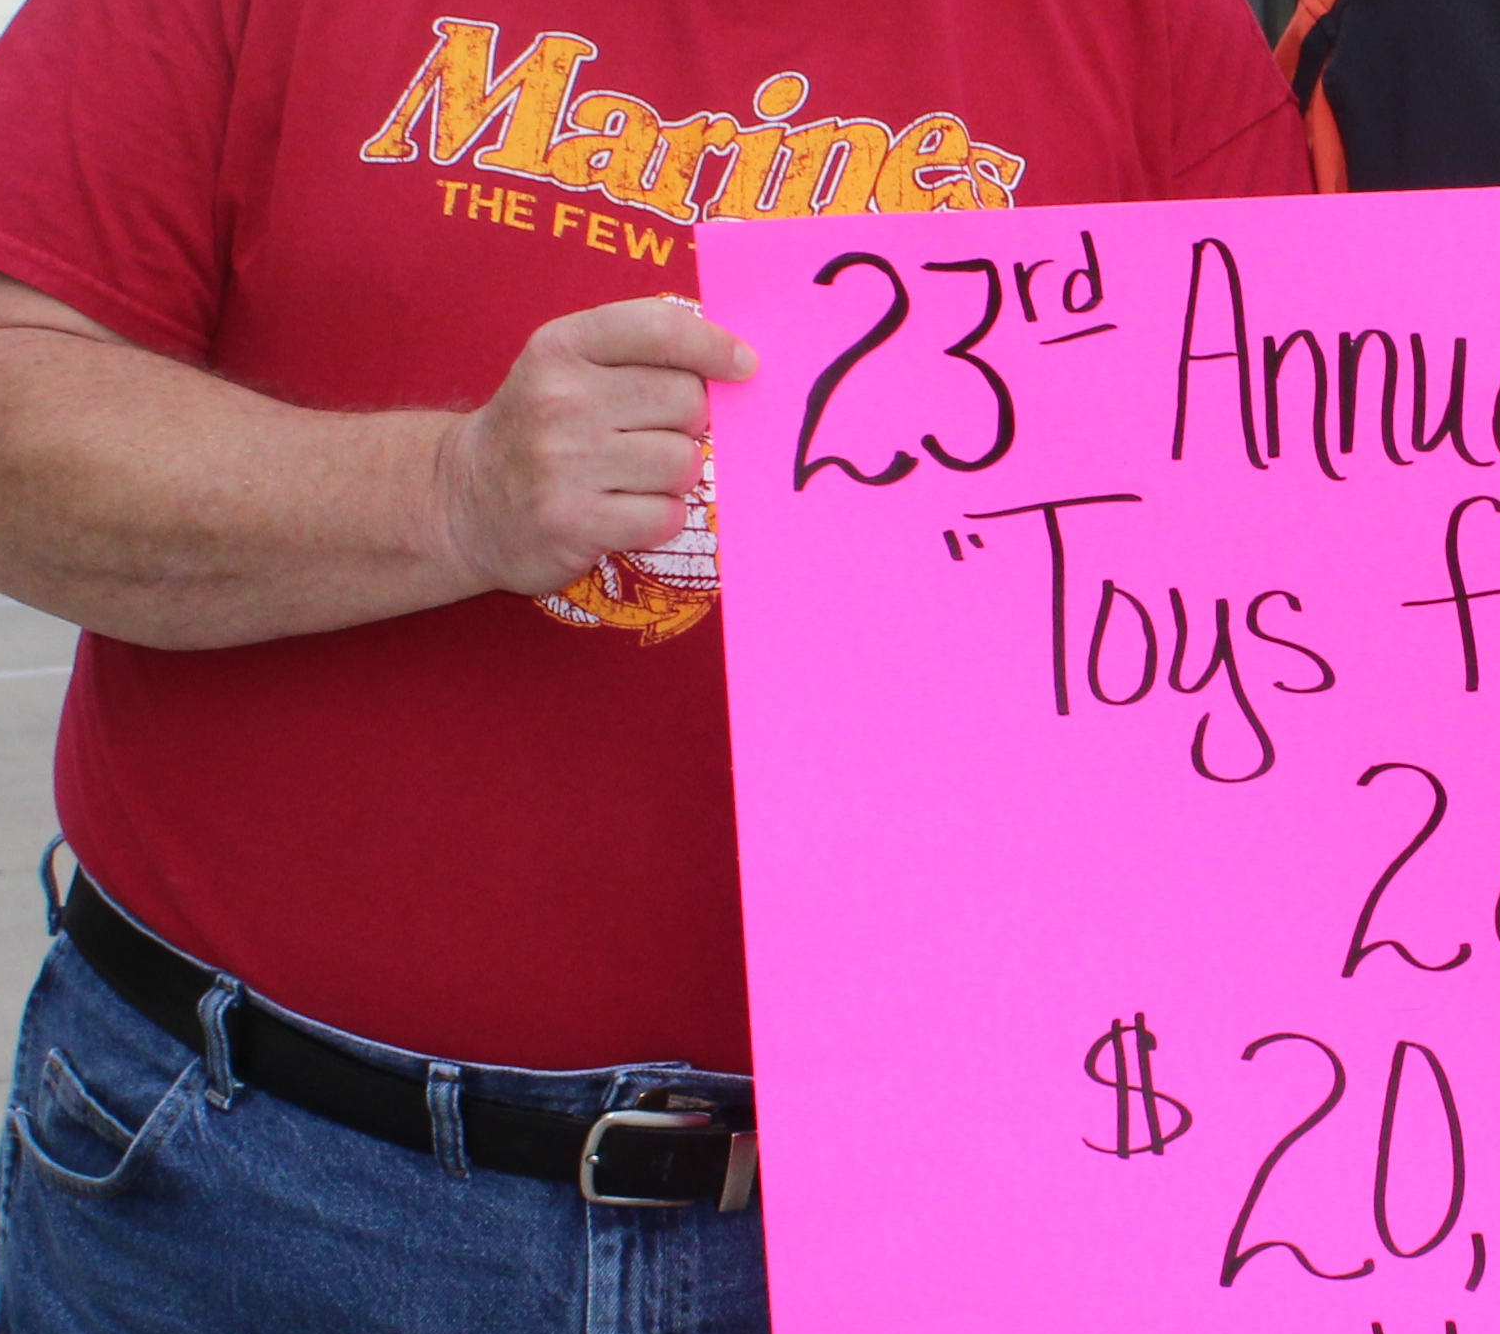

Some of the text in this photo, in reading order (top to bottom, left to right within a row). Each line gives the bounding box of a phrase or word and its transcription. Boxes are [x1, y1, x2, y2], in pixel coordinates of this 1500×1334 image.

[359, 16, 1026, 225] Marines
[435, 178, 675, 268] THE FEW
[794, 231, 1116, 490] 23rd
